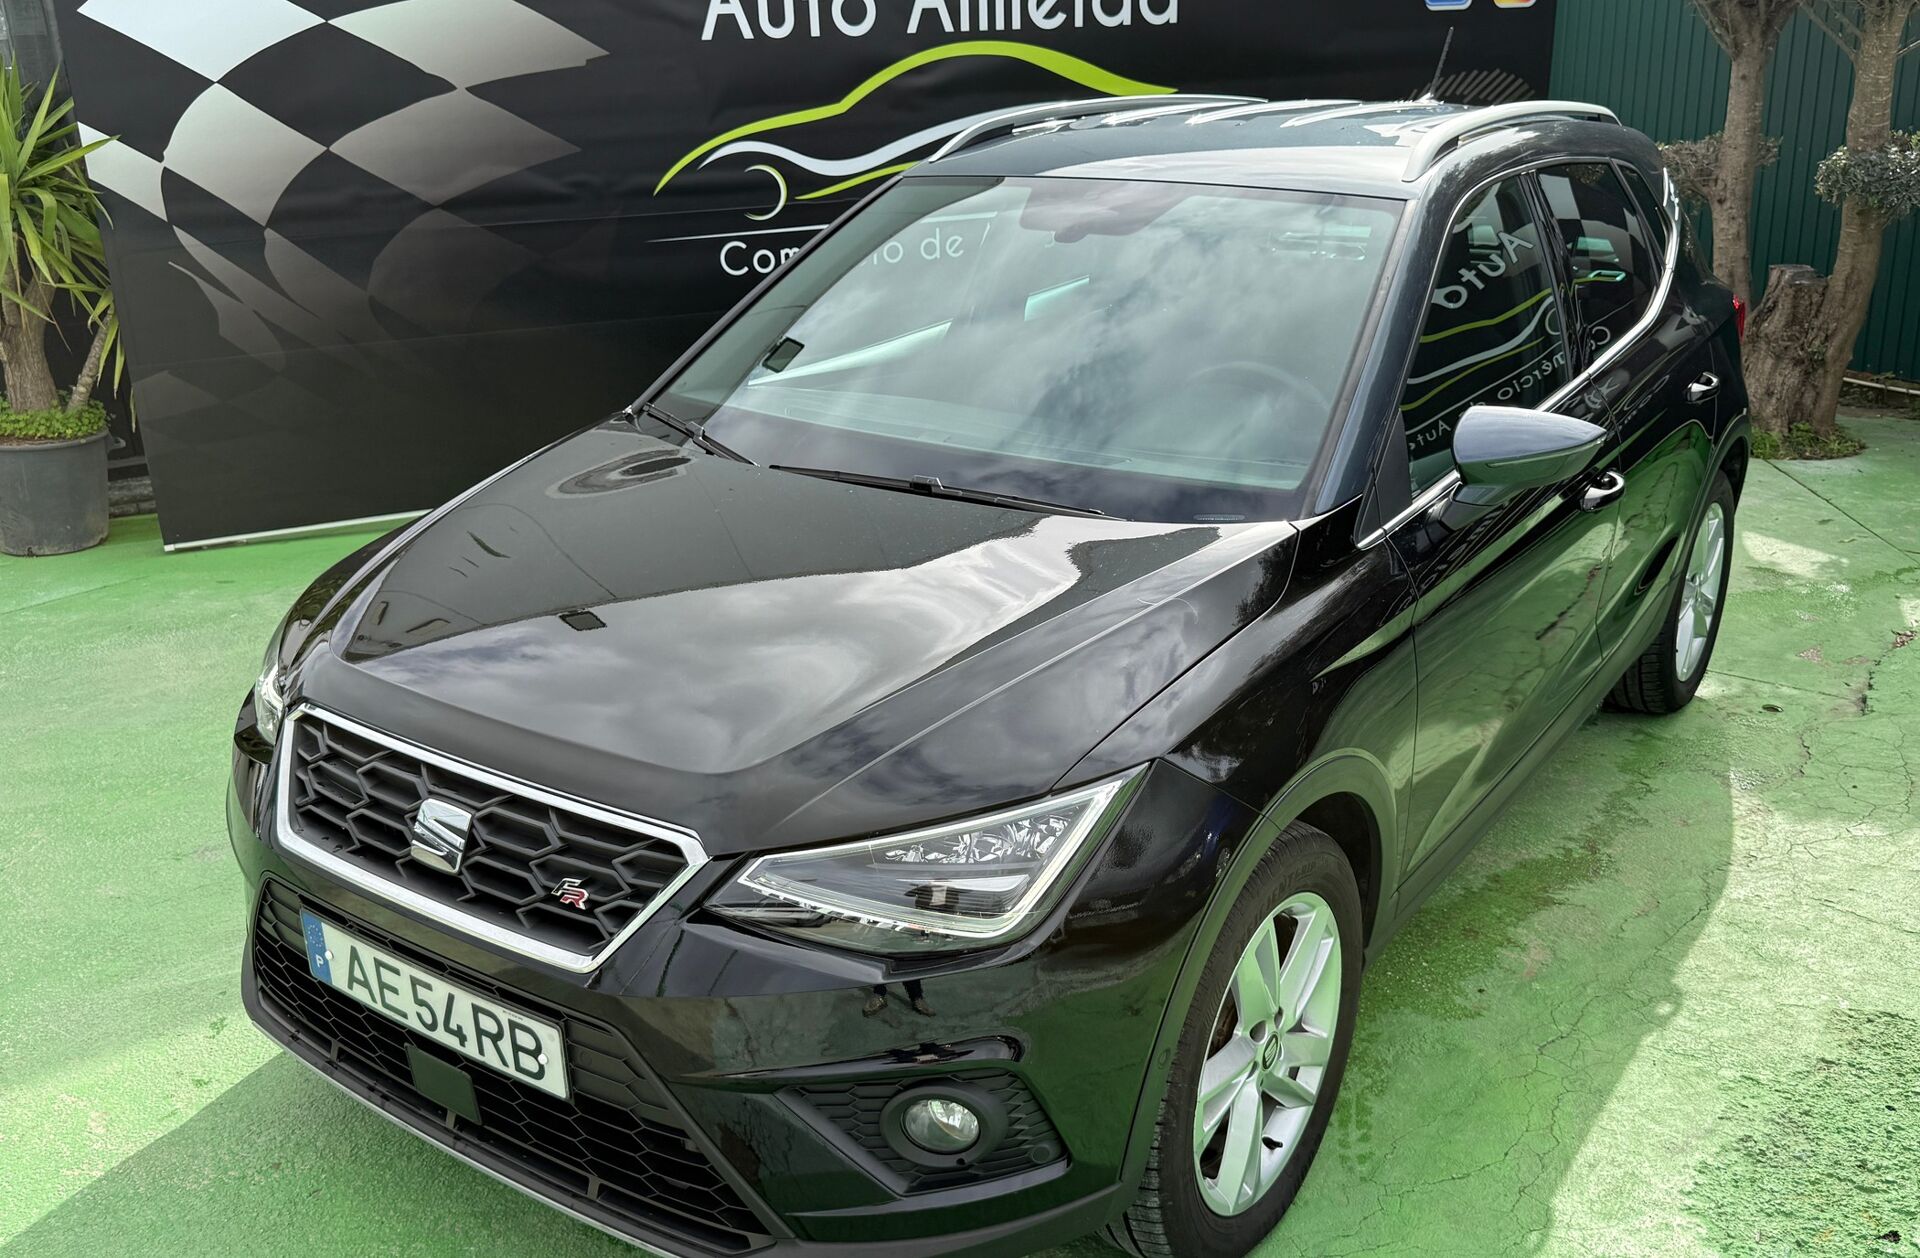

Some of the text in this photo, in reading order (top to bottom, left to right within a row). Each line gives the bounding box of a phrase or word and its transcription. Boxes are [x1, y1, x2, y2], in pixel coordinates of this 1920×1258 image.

[920, 227, 964, 260] de
[551, 877, 588, 910] FR
[315, 954, 325, 968] P
[347, 945, 546, 1081] AE54RB
